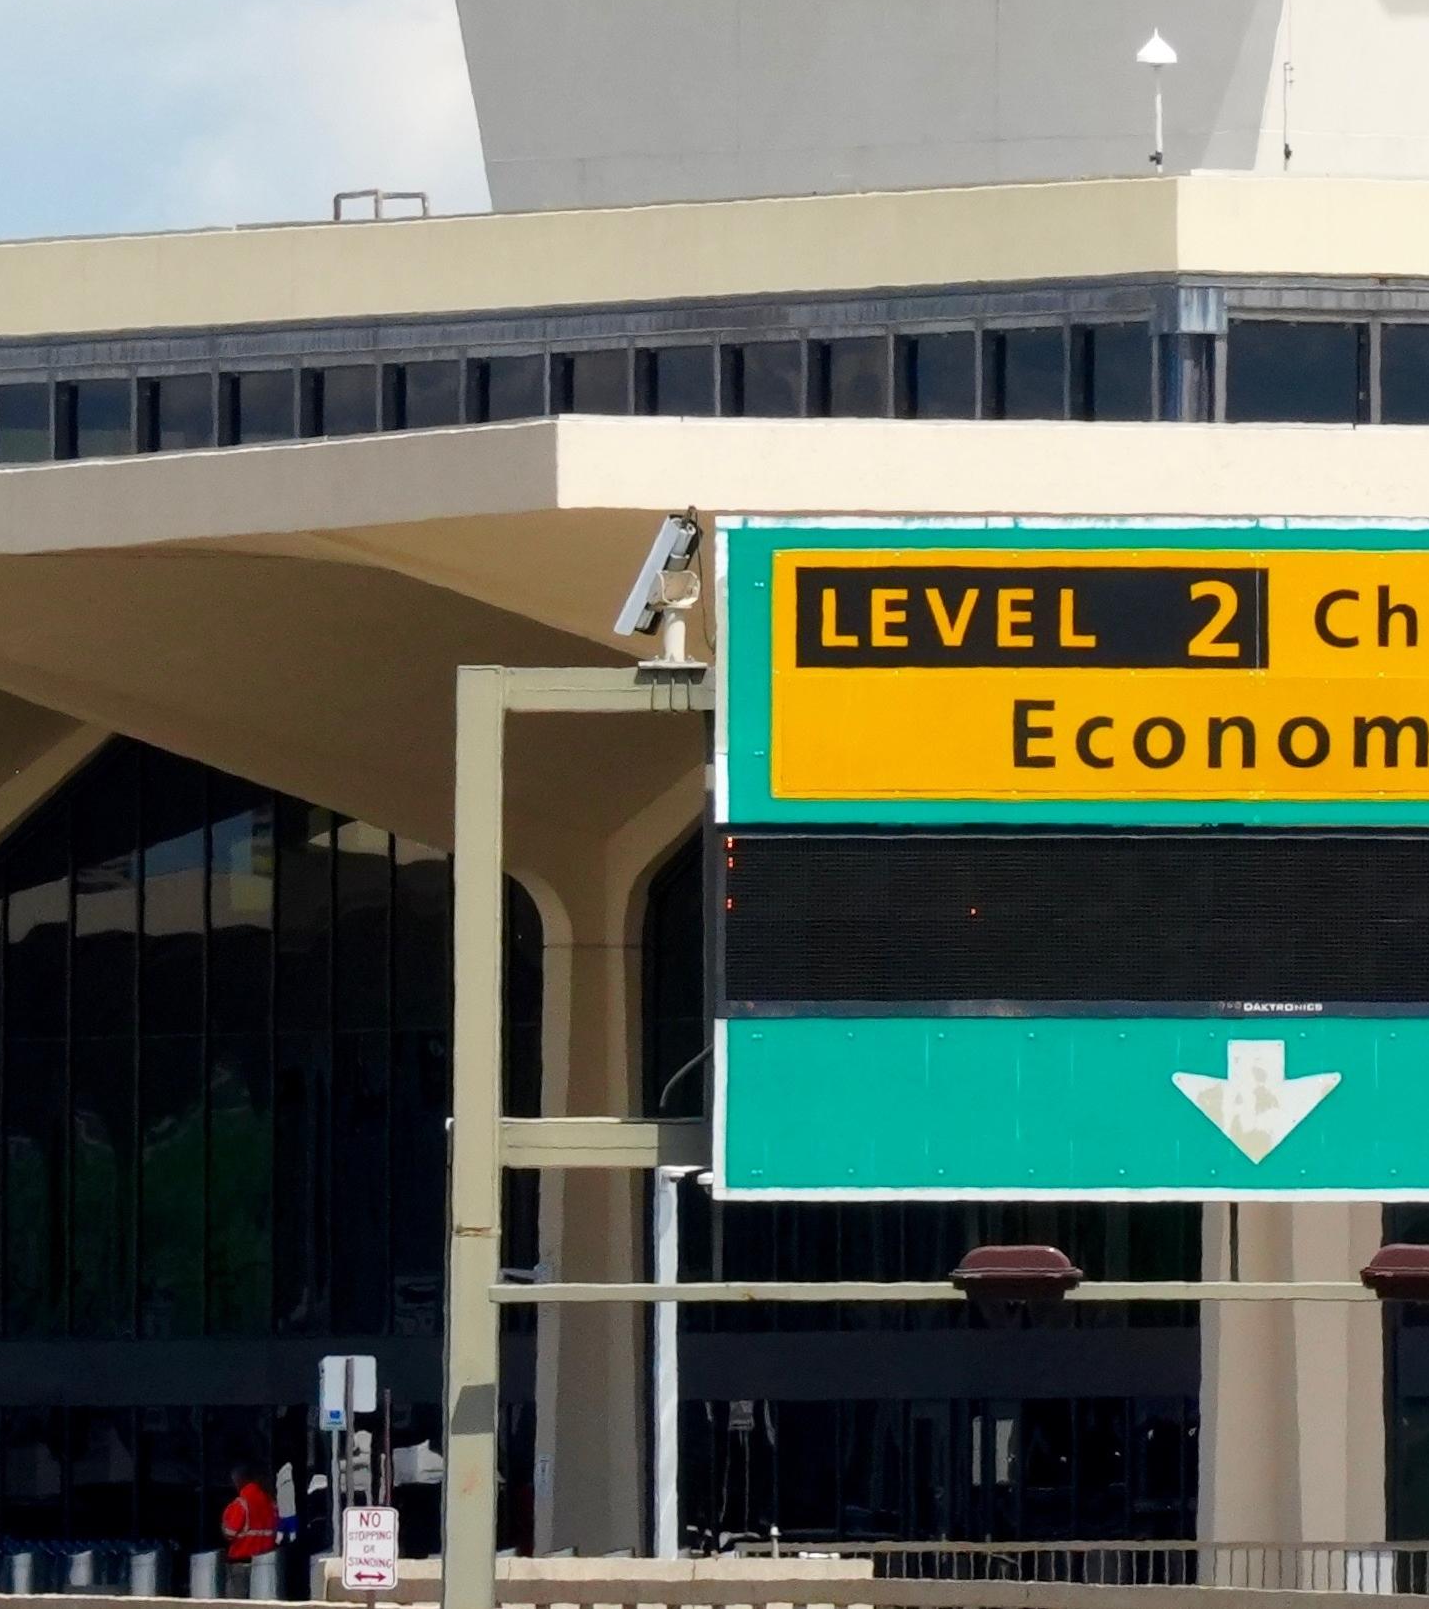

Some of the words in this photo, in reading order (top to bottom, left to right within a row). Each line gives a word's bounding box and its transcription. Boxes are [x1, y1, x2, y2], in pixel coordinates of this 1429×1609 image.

[821, 587, 1097, 648] LEVEL
[1187, 580, 1240, 658] 2
[1243, 1002, 1323, 1012] DAKTRONICS
[359, 1512, 381, 1528] NO
[348, 1530, 392, 1542] STOPPING
[347, 1557, 393, 1569] STANDING
